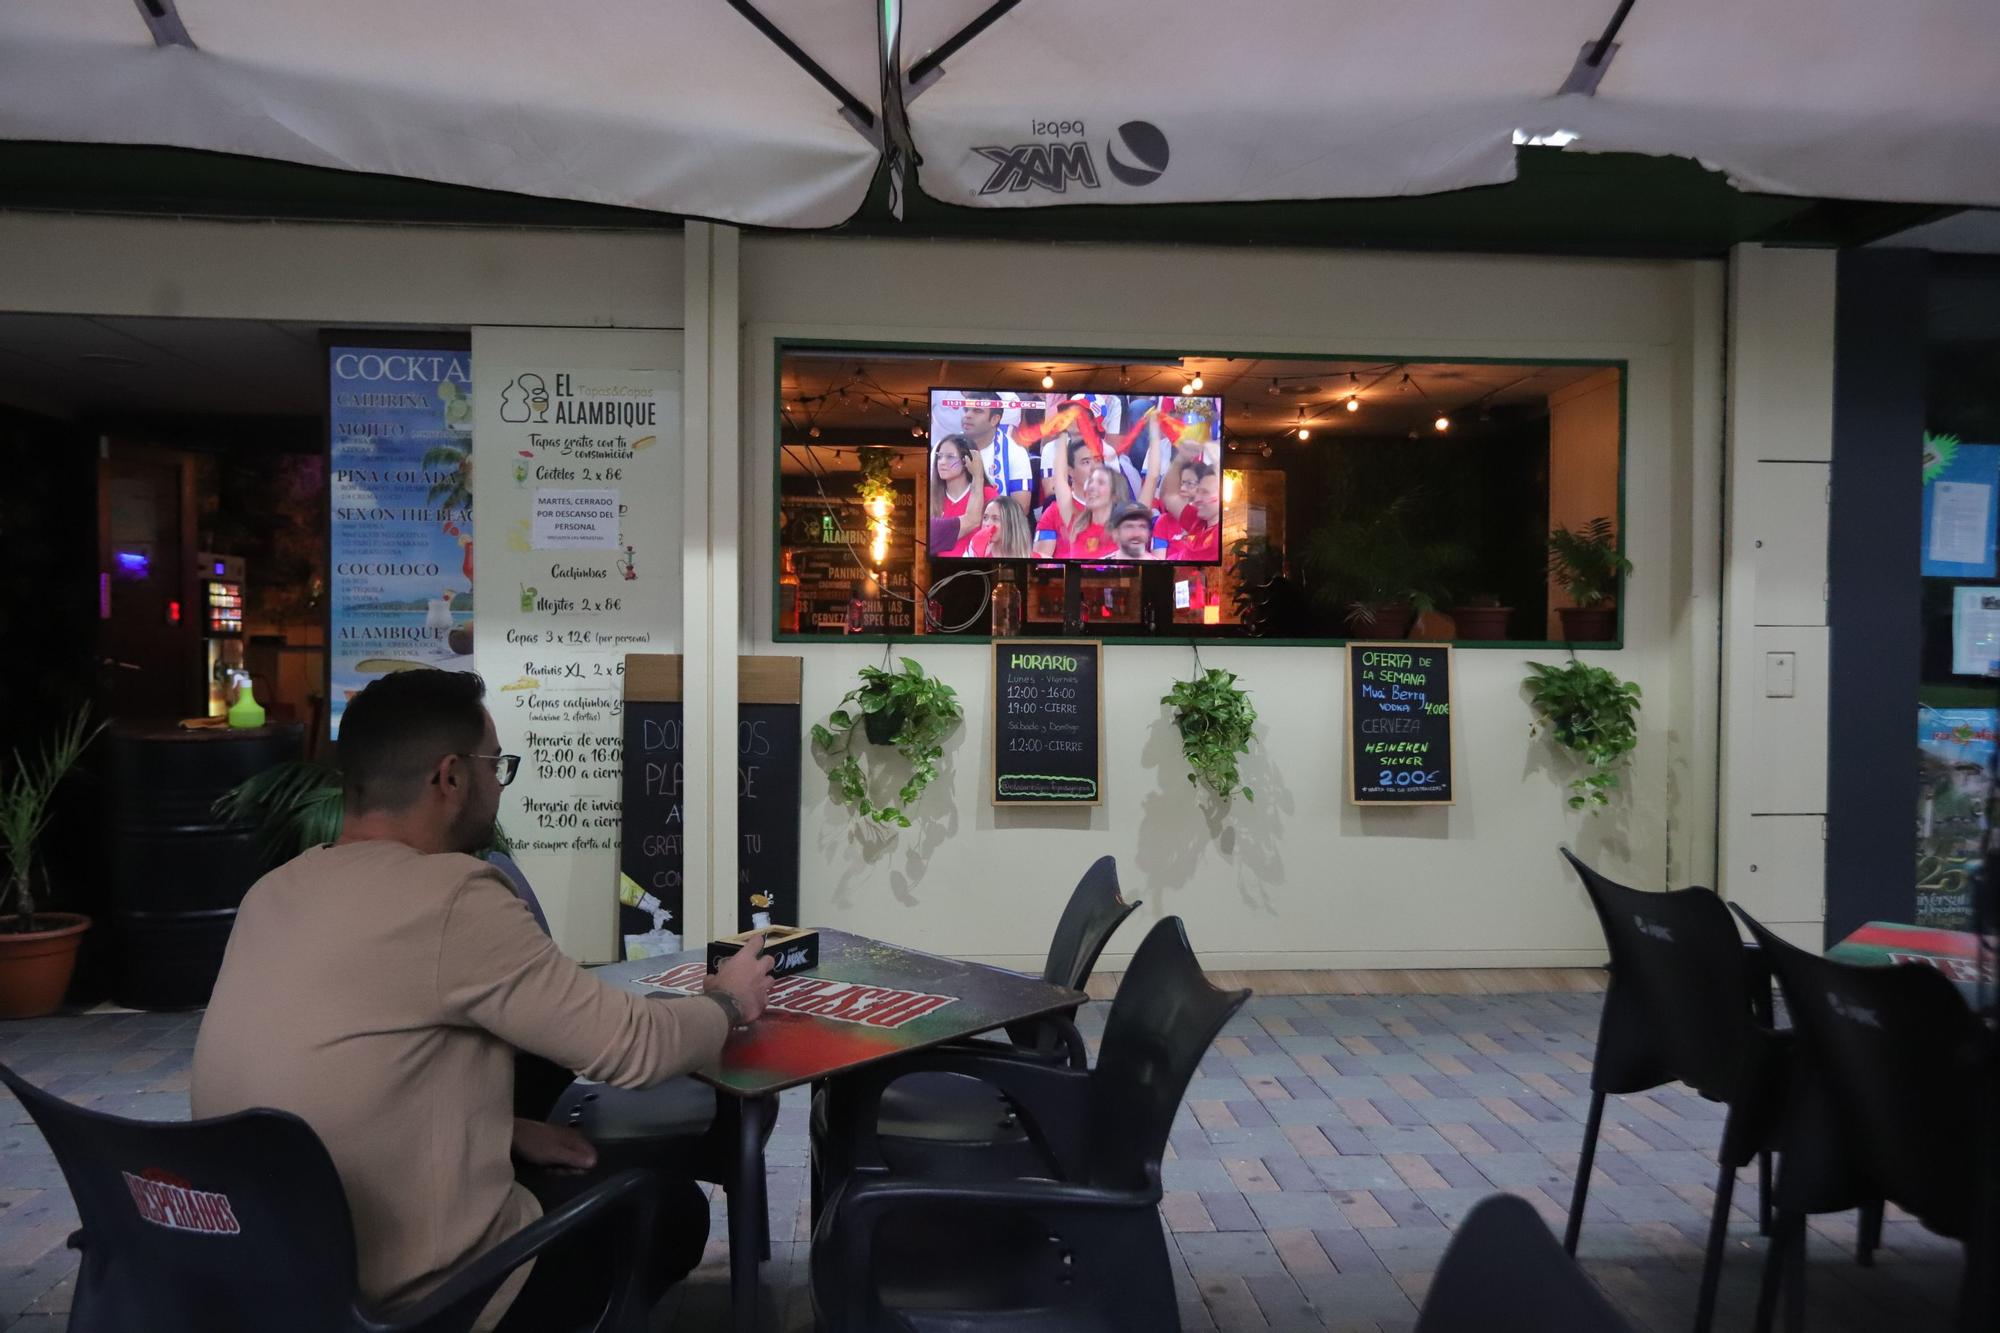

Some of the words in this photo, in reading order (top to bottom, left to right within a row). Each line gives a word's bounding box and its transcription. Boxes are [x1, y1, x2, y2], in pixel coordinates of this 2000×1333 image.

[556, 373, 574, 397] EL
[556, 400, 656, 427] ALAMBIQUE
[337, 423, 405, 437] MOJITO
[528, 433, 561, 450] Tapas
[561, 435, 593, 456] gratis
[597, 439, 613, 448] con
[384, 470, 457, 484] COLADA
[582, 468, 592, 481] 2
[595, 472, 602, 481] x
[605, 468, 622, 481] 8€
[574, 498, 613, 506] CERRADO
[337, 508, 366, 520] SEX
[370, 508, 394, 520] ON
[401, 508, 432, 521] THE
[555, 510, 598, 518] DESCANSO
[554, 523, 596, 531] PERSONAL
[337, 563, 439, 576] COCOLOCO
[551, 563, 607, 580] Cachimbas
[536, 597, 574, 615] Mojitos
[581, 598, 592, 611] 2
[594, 603, 601, 611] x
[604, 598, 621, 611] 8€
[337, 627, 444, 642] ALAMBIQUE
[507, 629, 538, 645] Copas
[545, 630, 553, 643] 3
[557, 635, 564, 644] x
[567, 630, 591, 644] 12€
[1011, 653, 1078, 673] HORARIO
[1362, 651, 1412, 669] OFERTA
[1419, 657, 1433, 667] DE
[523, 661, 562, 676] Paninis
[564, 663, 586, 679] XL
[593, 664, 602, 676] 2
[606, 668, 612, 676] x
[1362, 670, 1374, 680] LA
[1379, 670, 1426, 686] SEMANA
[1007, 686, 1038, 700] 12:00
[1047, 687, 1076, 699] 16:00
[1391, 684, 1426, 710] Berry
[516, 695, 524, 708] 5
[528, 694, 560, 711] Copas
[563, 695, 610, 710] cachimba
[1008, 702, 1037, 715] 19:00
[1044, 703, 1078, 714] CIERRE
[1379, 703, 1411, 713] VODKA
[563, 712, 570, 721] 2
[1361, 717, 1421, 735] CERVEZA
[525, 731, 572, 749] Horario
[577, 733, 591, 746] de
[1009, 737, 1043, 752] 12:00
[1048, 740, 1084, 752] CIERRE
[1364, 742, 1430, 754] HEINEKEN
[534, 749, 574, 763] 12:00
[578, 755, 585, 763] a
[1379, 756, 1424, 767] SILVER
[537, 765, 576, 779] 19:00
[581, 771, 588, 779] a
[593, 768, 623, 779] cierr
[520, 796, 570, 814] Horario
[574, 798, 588, 811] de
[591, 801, 622, 811] invie
[537, 814, 577, 828] 12:00
[582, 820, 589, 828] a
[593, 817, 622, 828] cierr
[533, 839, 568, 852] siempre
[571, 838, 599, 851] oferta
[601, 838, 610, 849] al
[642, 834, 684, 857] GRAT
[743, 834, 761, 853] TU
